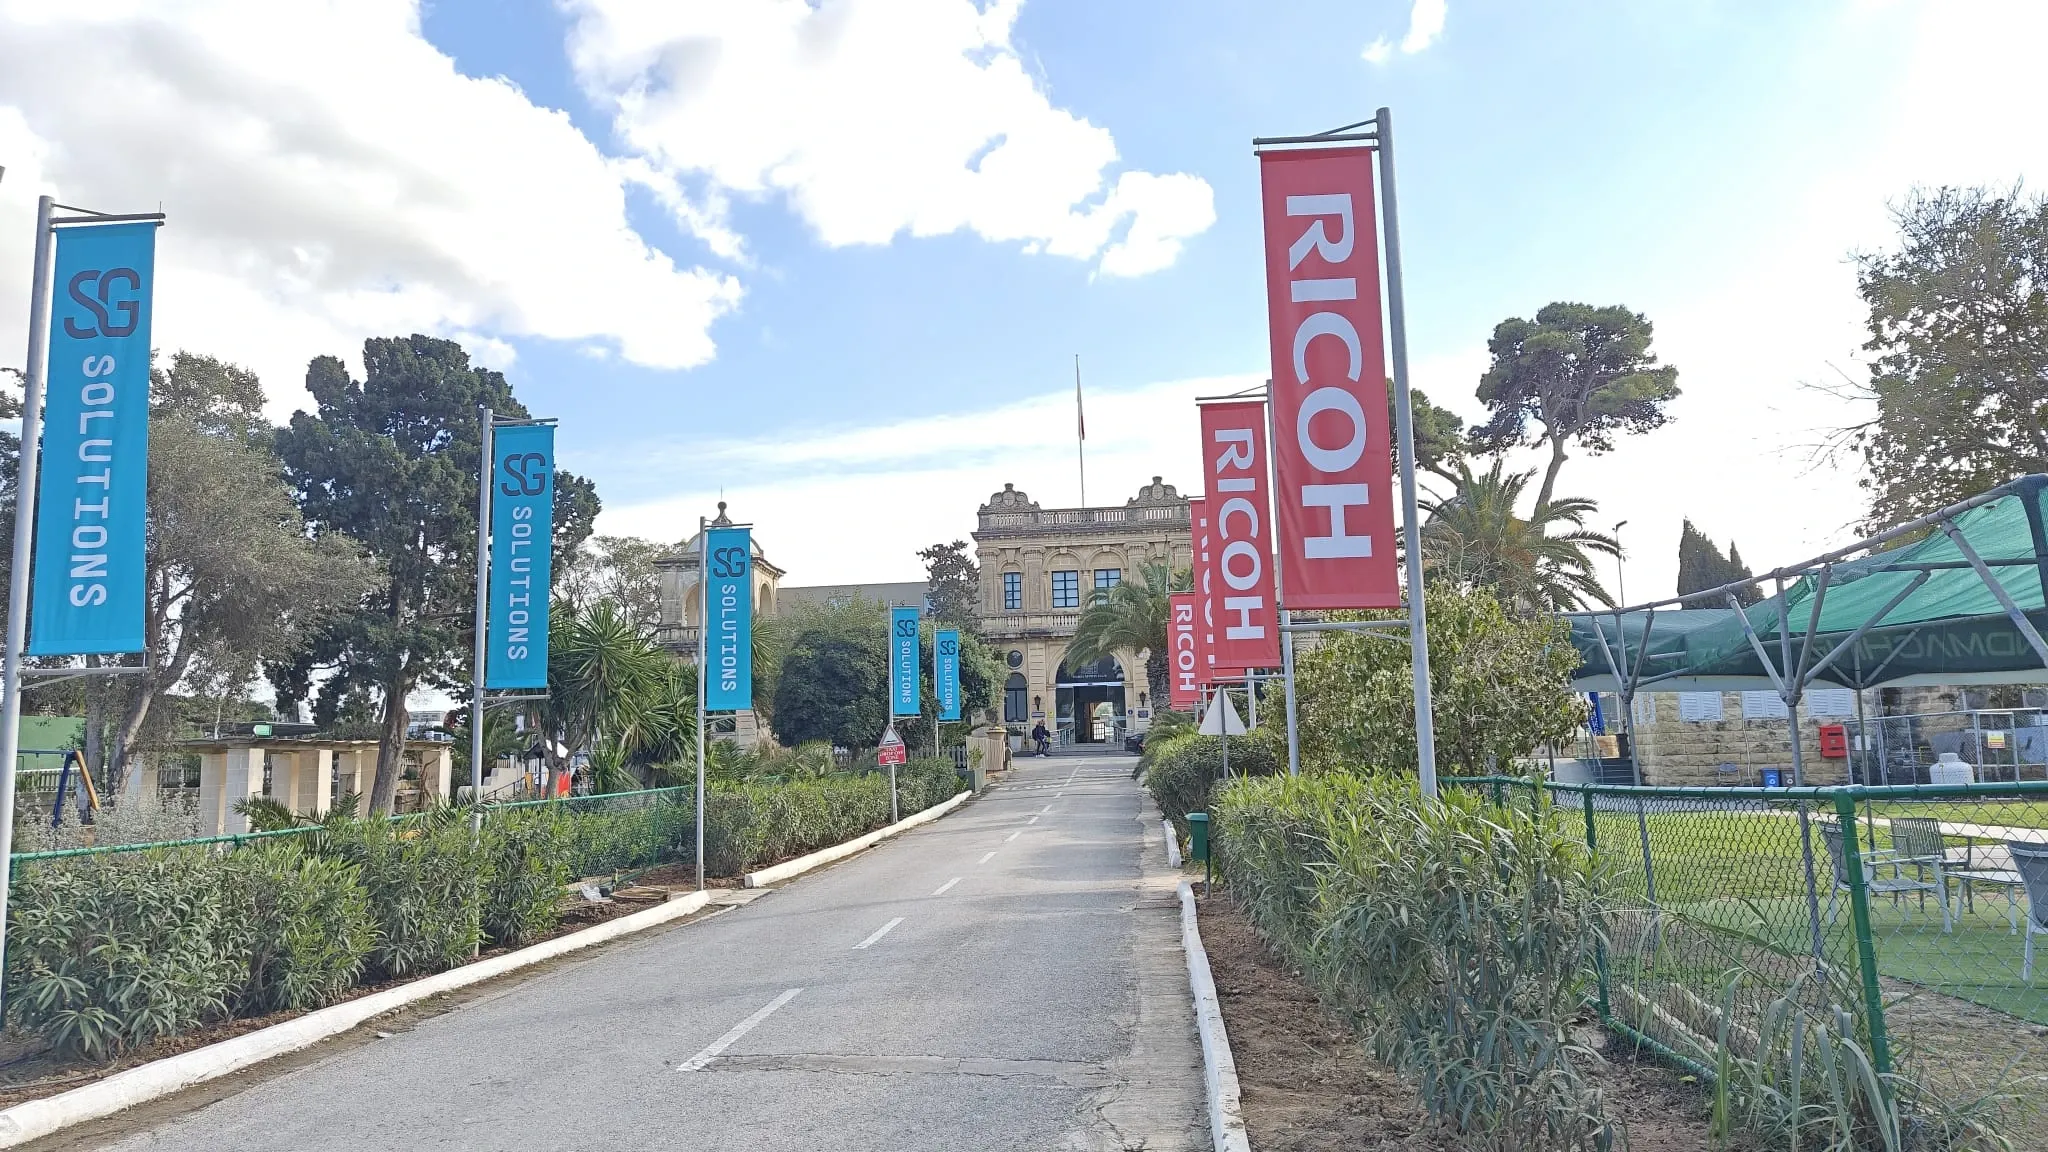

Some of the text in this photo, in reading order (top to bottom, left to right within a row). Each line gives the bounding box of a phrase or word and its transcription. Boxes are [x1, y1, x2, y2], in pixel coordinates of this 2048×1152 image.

[63, 267, 141, 340] SG
[1286, 193, 1373, 559] RICOH
[70, 355, 116, 607] SOLUTIONS
[501, 452, 546, 497] SG
[713, 547, 746, 578] SG
[1214, 428, 1265, 640] RICOH
[508, 506, 532, 661] SOLUTIONS
[721, 584, 737, 691] SOLUTIONS
[902, 641, 912, 704] SOLUTIONS
[1175, 605, 1196, 691] RICOH
[945, 658, 953, 711] SOLUTIONS
